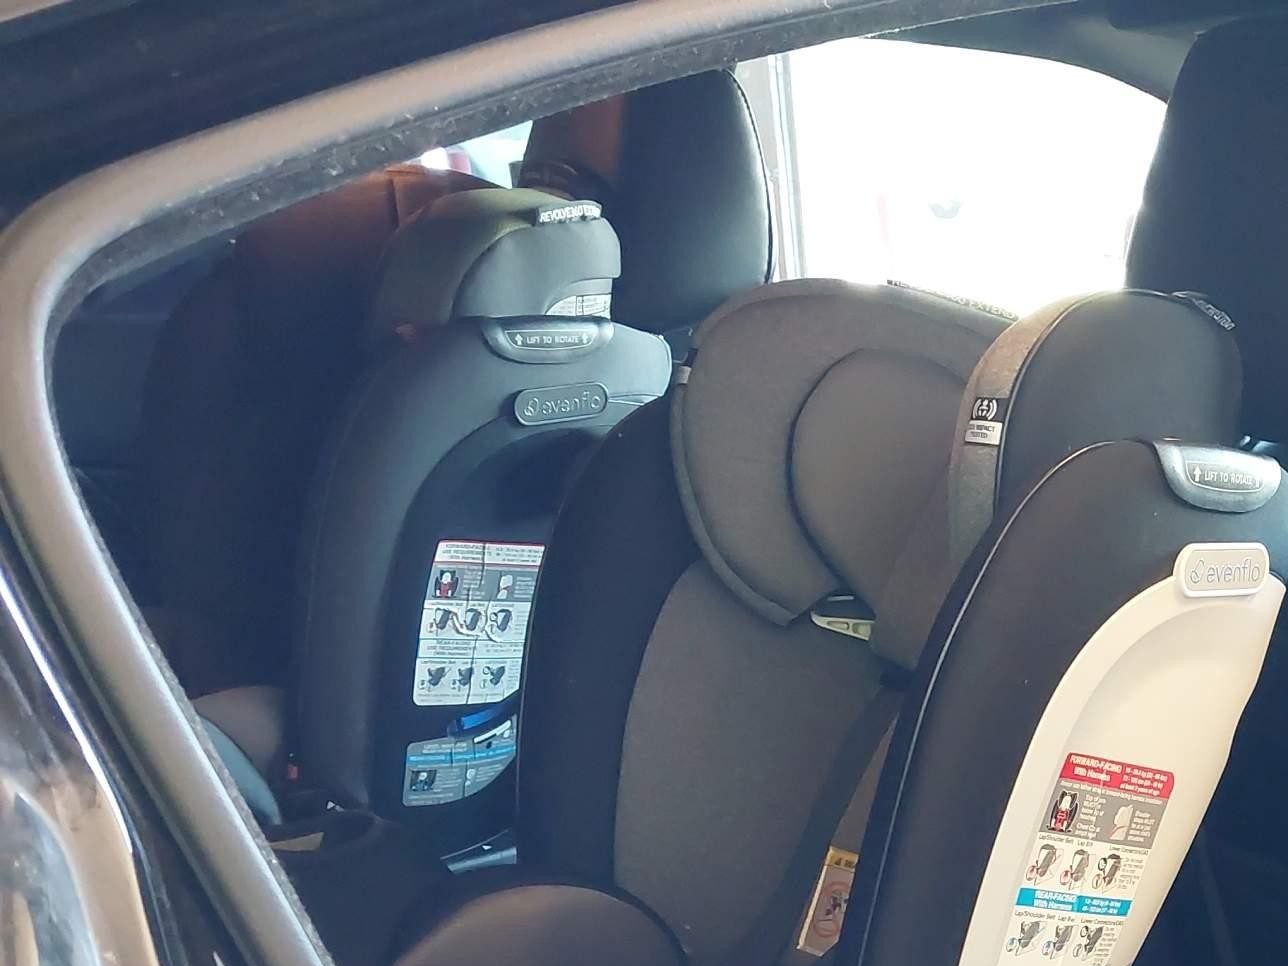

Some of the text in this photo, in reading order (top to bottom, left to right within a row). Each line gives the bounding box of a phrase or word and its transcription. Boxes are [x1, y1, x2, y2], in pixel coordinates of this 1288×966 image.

[526, 335, 579, 344] LIFT TO ROTATE
[1205, 470, 1252, 485] LIFT TO ROTATE
[1206, 558, 1261, 583] evenflo
